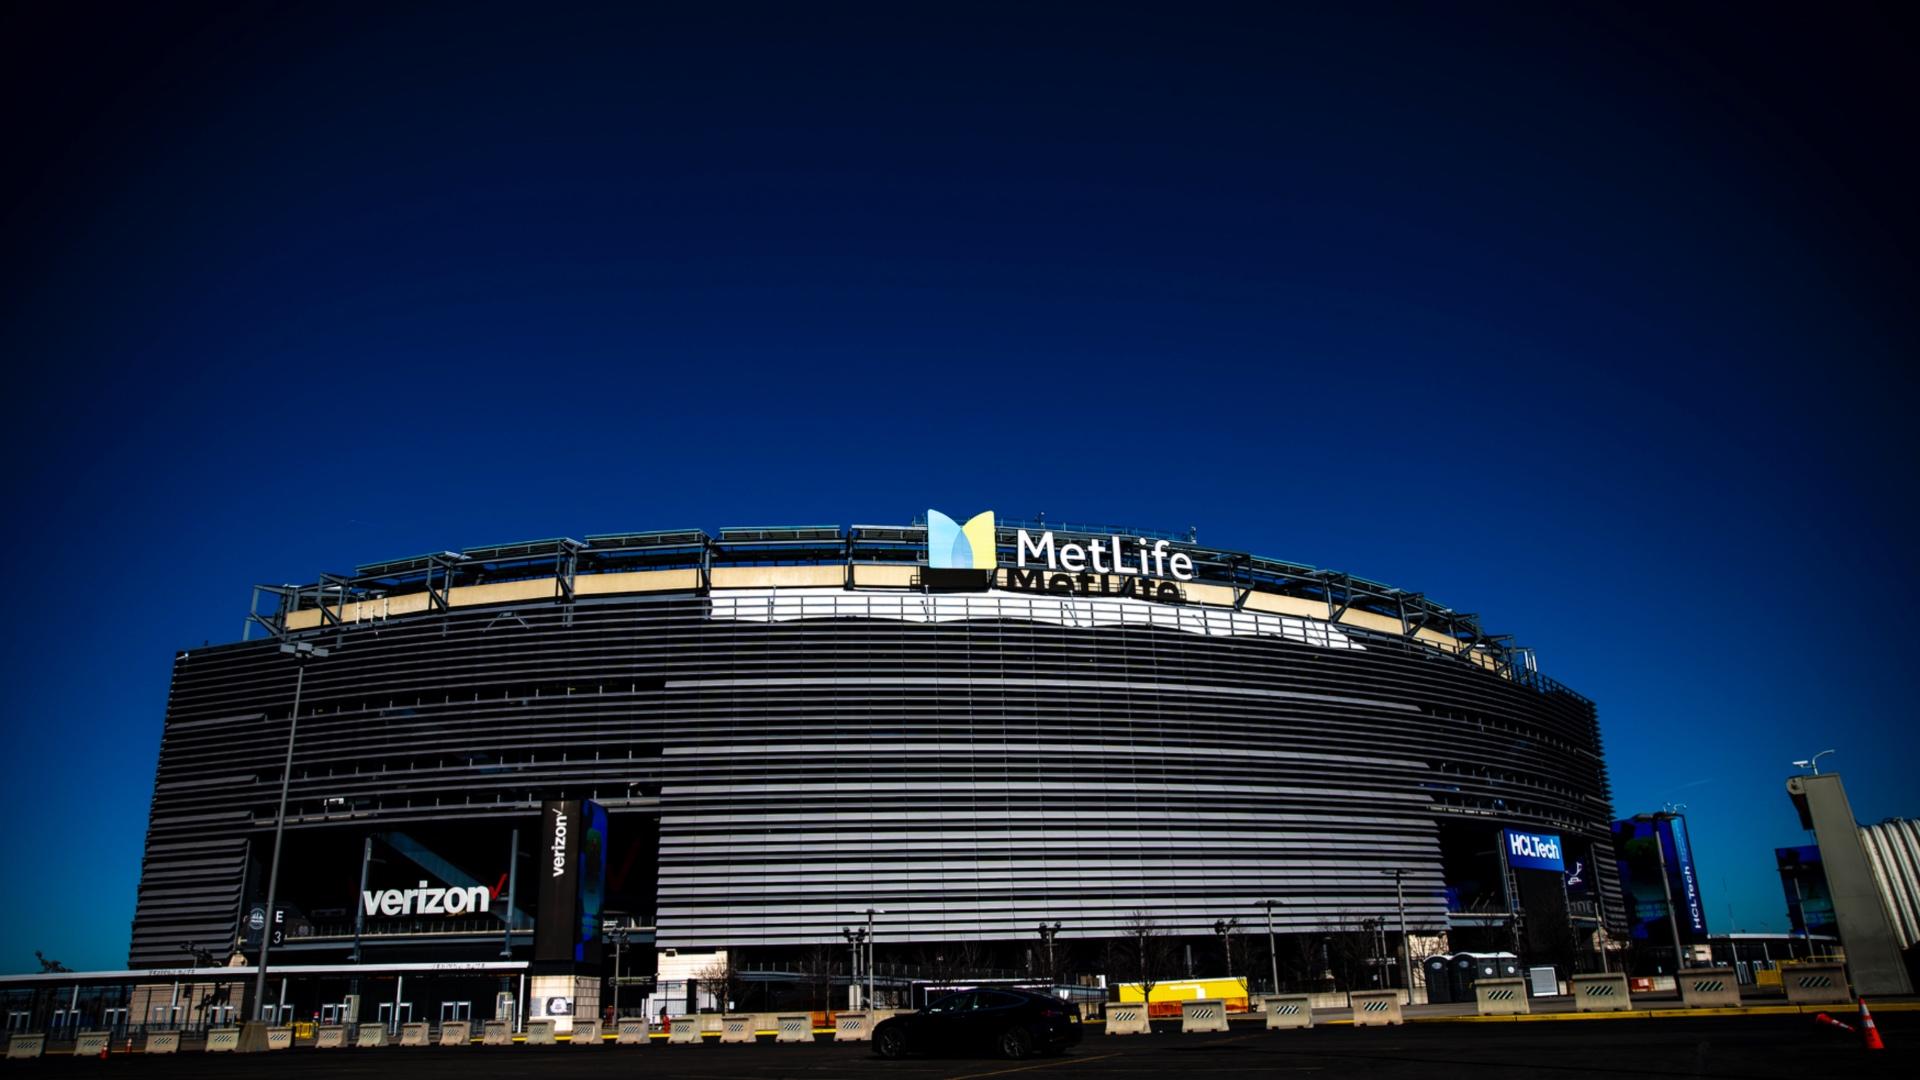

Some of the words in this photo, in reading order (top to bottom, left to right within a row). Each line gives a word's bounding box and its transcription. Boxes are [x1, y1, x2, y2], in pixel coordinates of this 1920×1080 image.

[1018, 530, 1192, 580] MetLife
[551, 815, 567, 878] verizon
[1509, 834, 1560, 859] HCLTech
[363, 881, 489, 915] verizon
[1684, 865, 1702, 929] HCLTech
[275, 910, 284, 923] E
[273, 931, 281, 944] 3
